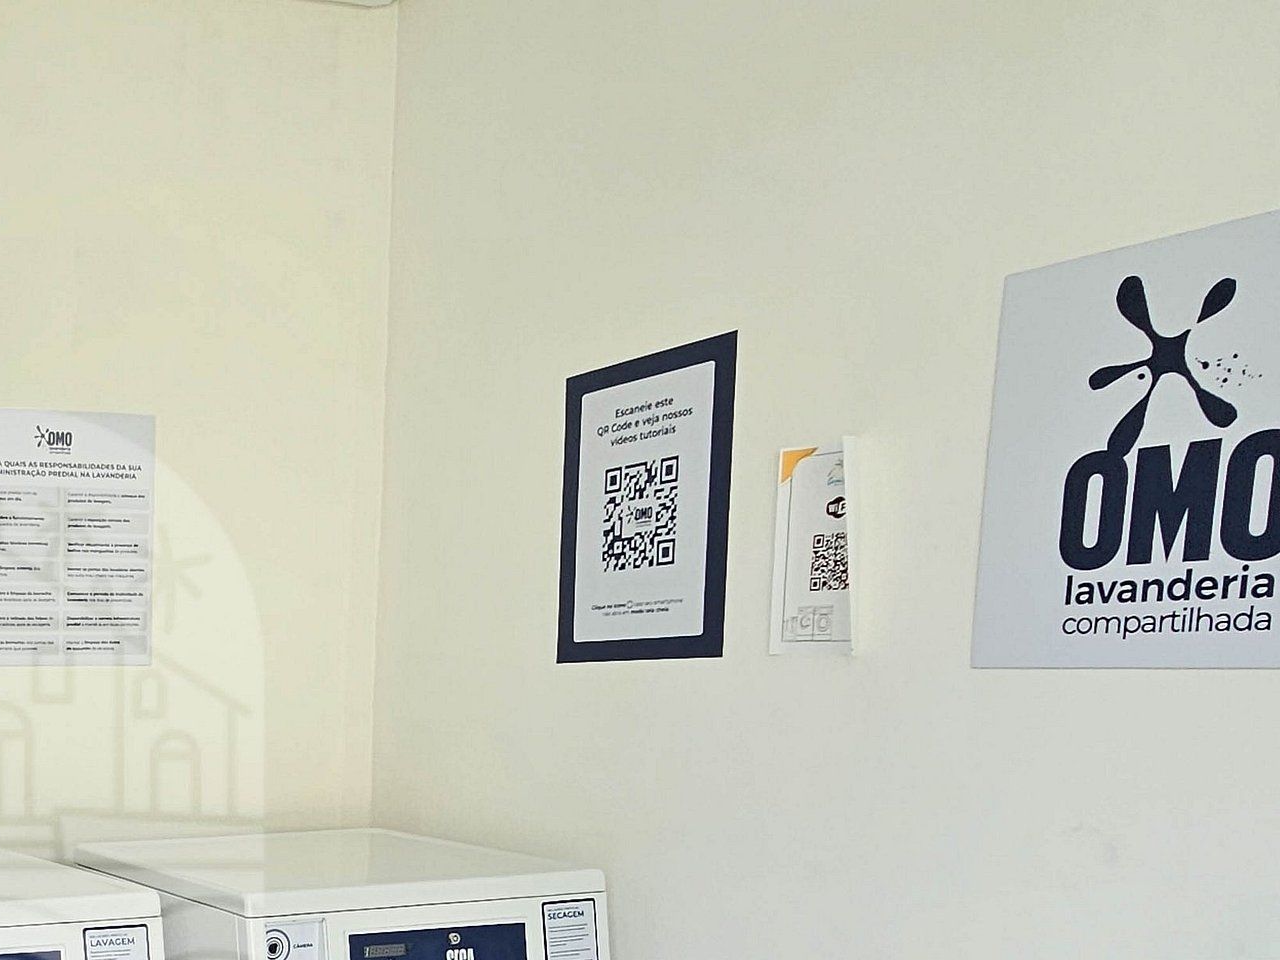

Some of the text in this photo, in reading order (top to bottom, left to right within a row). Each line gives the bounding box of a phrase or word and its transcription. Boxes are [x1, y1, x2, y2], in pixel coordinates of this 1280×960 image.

[615, 397, 674, 419] Escaneie este
[597, 407, 694, 437] QR Code e veja nossos
[47, 430, 73, 447] OMO
[639, 423, 677, 441] tutoriais
[4, 460, 27, 468] QUAIS
[128, 464, 142, 472] SUA
[92, 471, 137, 480] LAVANDERIA
[1058, 427, 1280, 571] OMO
[1063, 563, 1275, 606] lavanderia
[1061, 605, 1274, 640] compartilhada
[547, 909, 585, 920] SECAGEM
[89, 936, 136, 948] LAVAGEM
